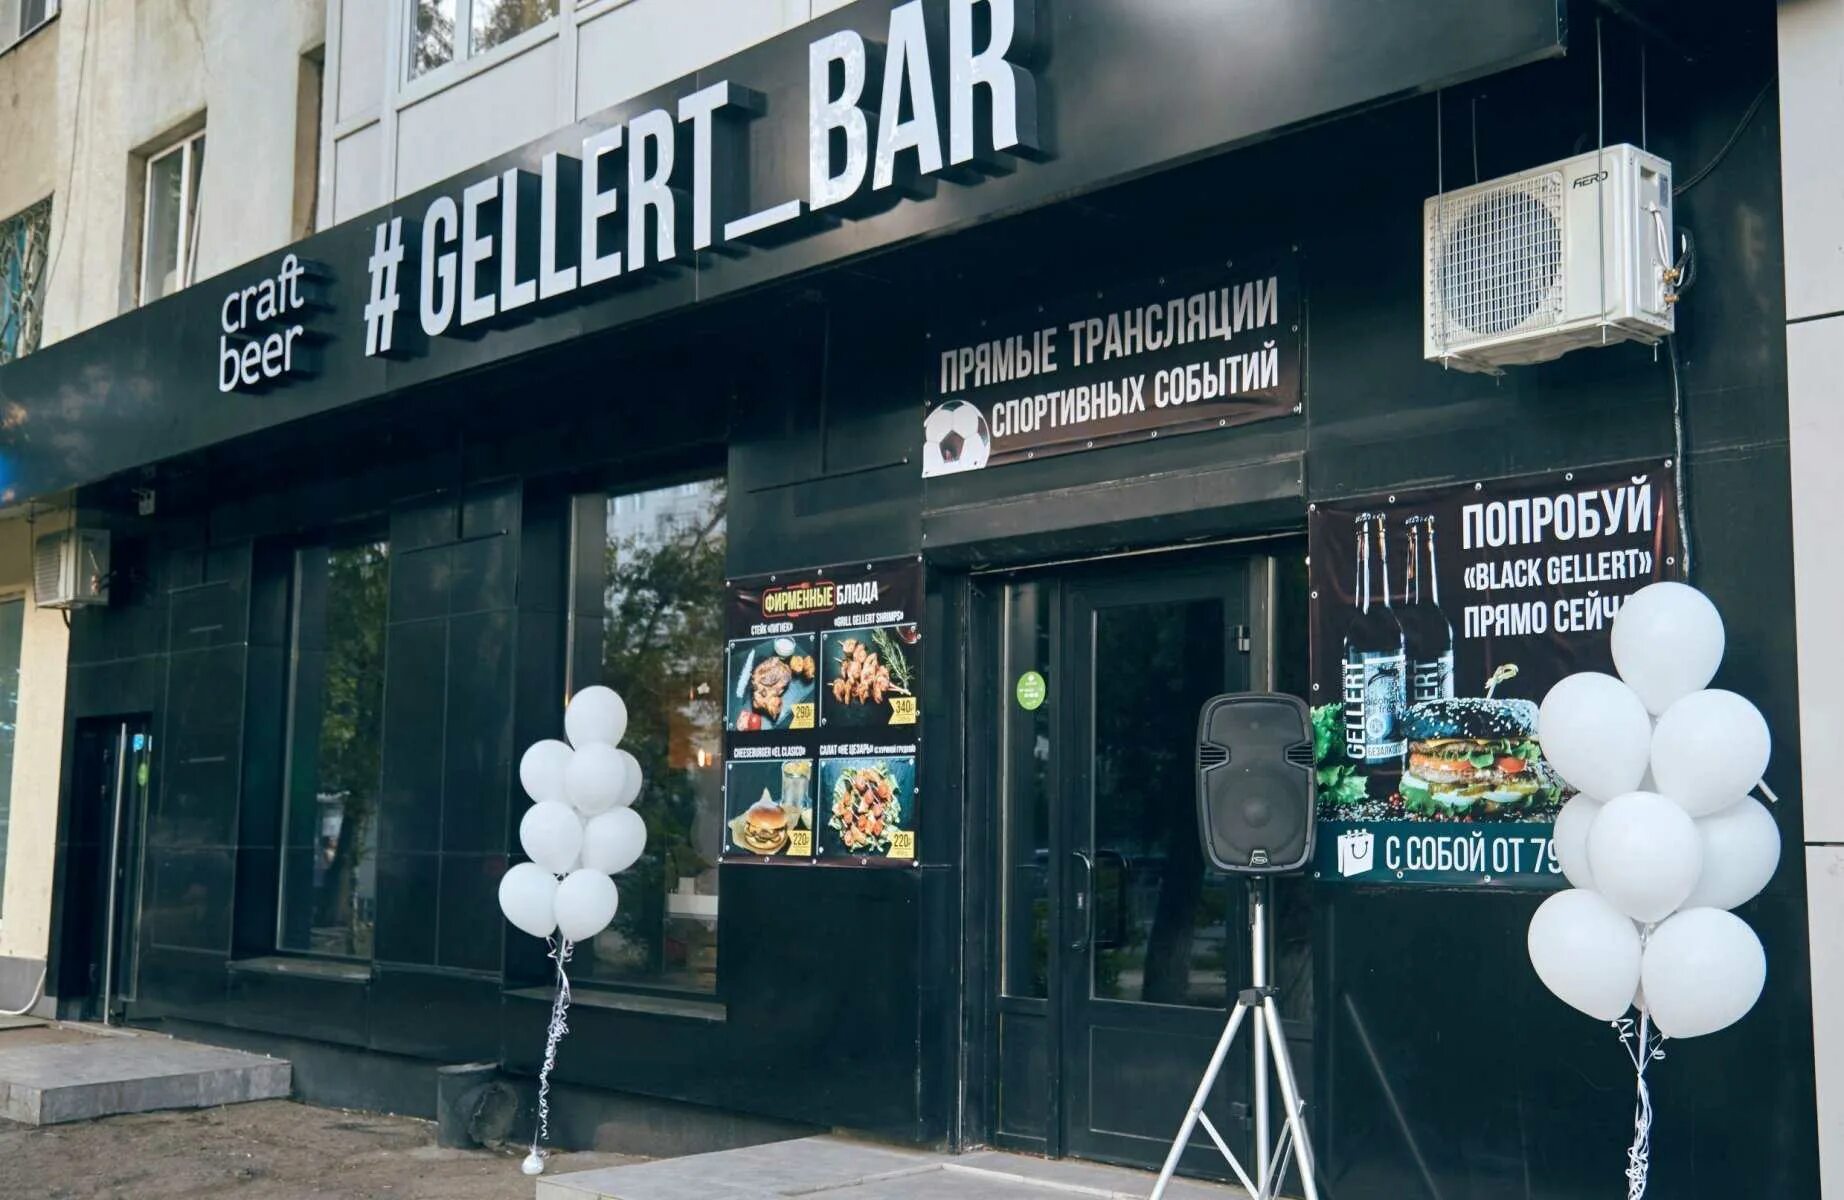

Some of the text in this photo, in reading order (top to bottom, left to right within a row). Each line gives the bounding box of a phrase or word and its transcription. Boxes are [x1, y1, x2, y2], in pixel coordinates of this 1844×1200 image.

[221, 253, 305, 334] craft
[219, 324, 304, 393] beer
[940, 275, 1278, 394] ПРЯМЫЕ ТРАНСЛЯЦИИ
[991, 340, 1278, 438] СПОРТИВНЫХ СОБЫТИЙ
[1462, 474, 1652, 550] ПОПРОБУЙ
[765, 580, 879, 612] ФИРМЕННЫЕ БЛЮДА
[1464, 549, 1653, 591] «BLACK GELLERT»
[1464, 590, 1632, 639] ПРЯМО СЕЙЧ
[1346, 659, 1366, 760] GELLERT
[1413, 660, 1438, 701] ERT
[1386, 835, 1400, 870] С
[1407, 830, 1485, 872] СОБОЙ
[1492, 836, 1524, 873] ОТ
